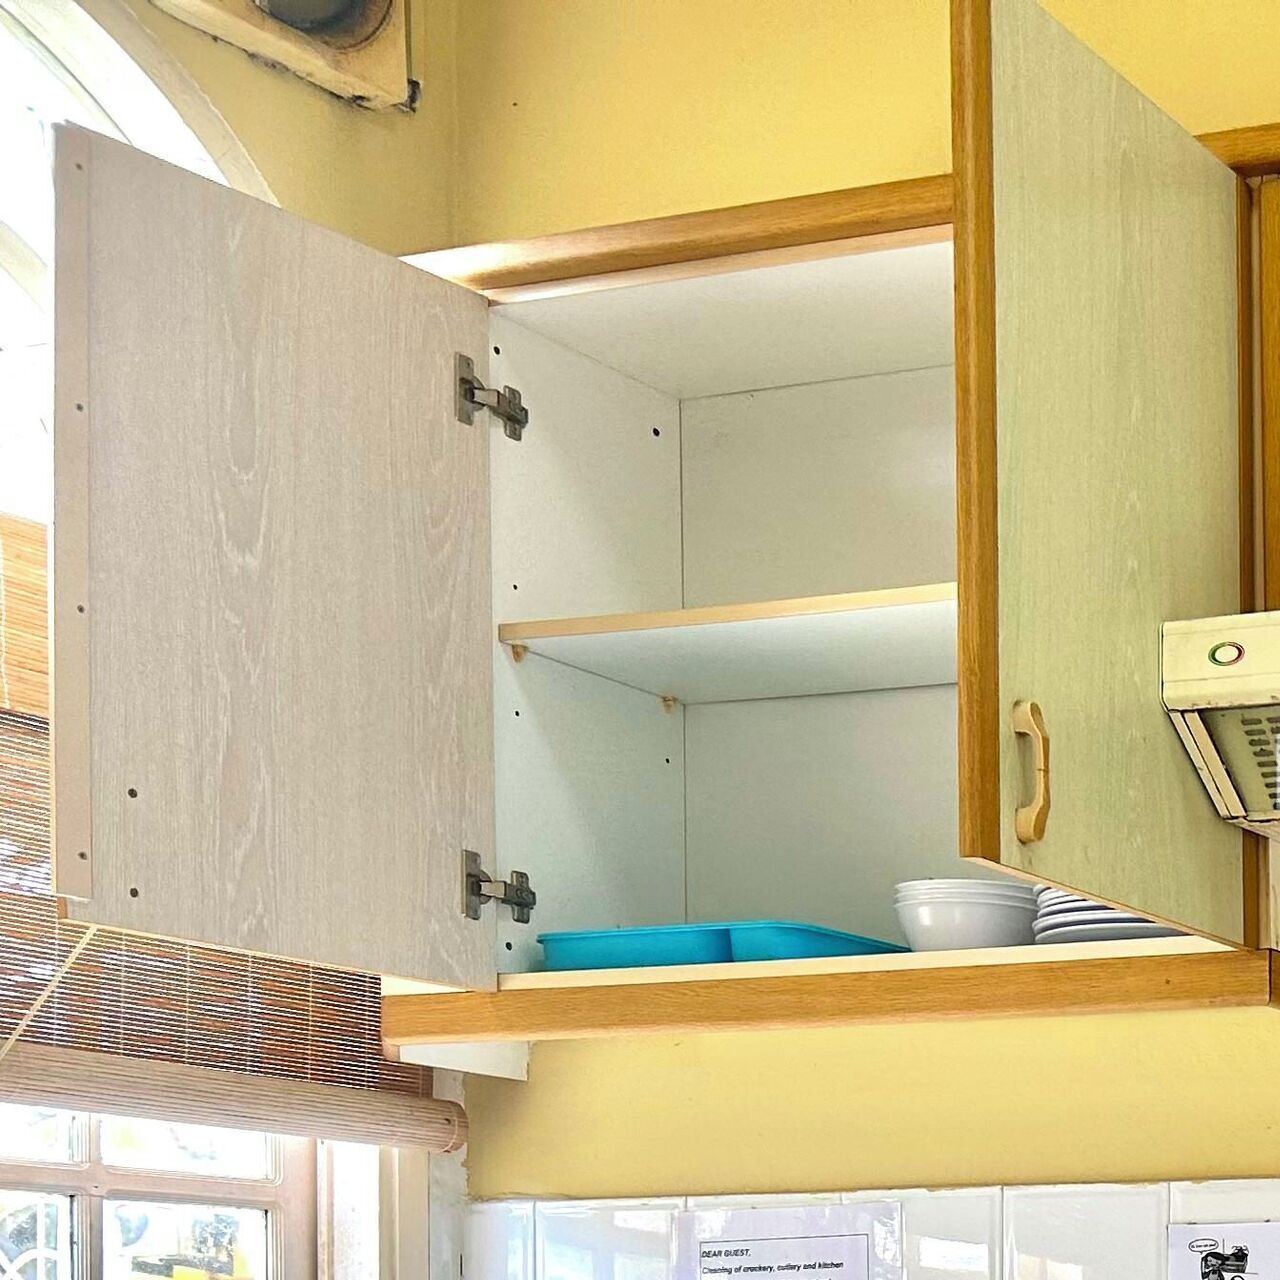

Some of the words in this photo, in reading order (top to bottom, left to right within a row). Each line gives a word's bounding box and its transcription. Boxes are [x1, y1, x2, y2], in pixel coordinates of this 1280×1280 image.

[701, 1250, 722, 1258] DEAR
[734, 1265, 742, 1273] of
[803, 1262, 816, 1270] and
[818, 1261, 843, 1269] kitchen
